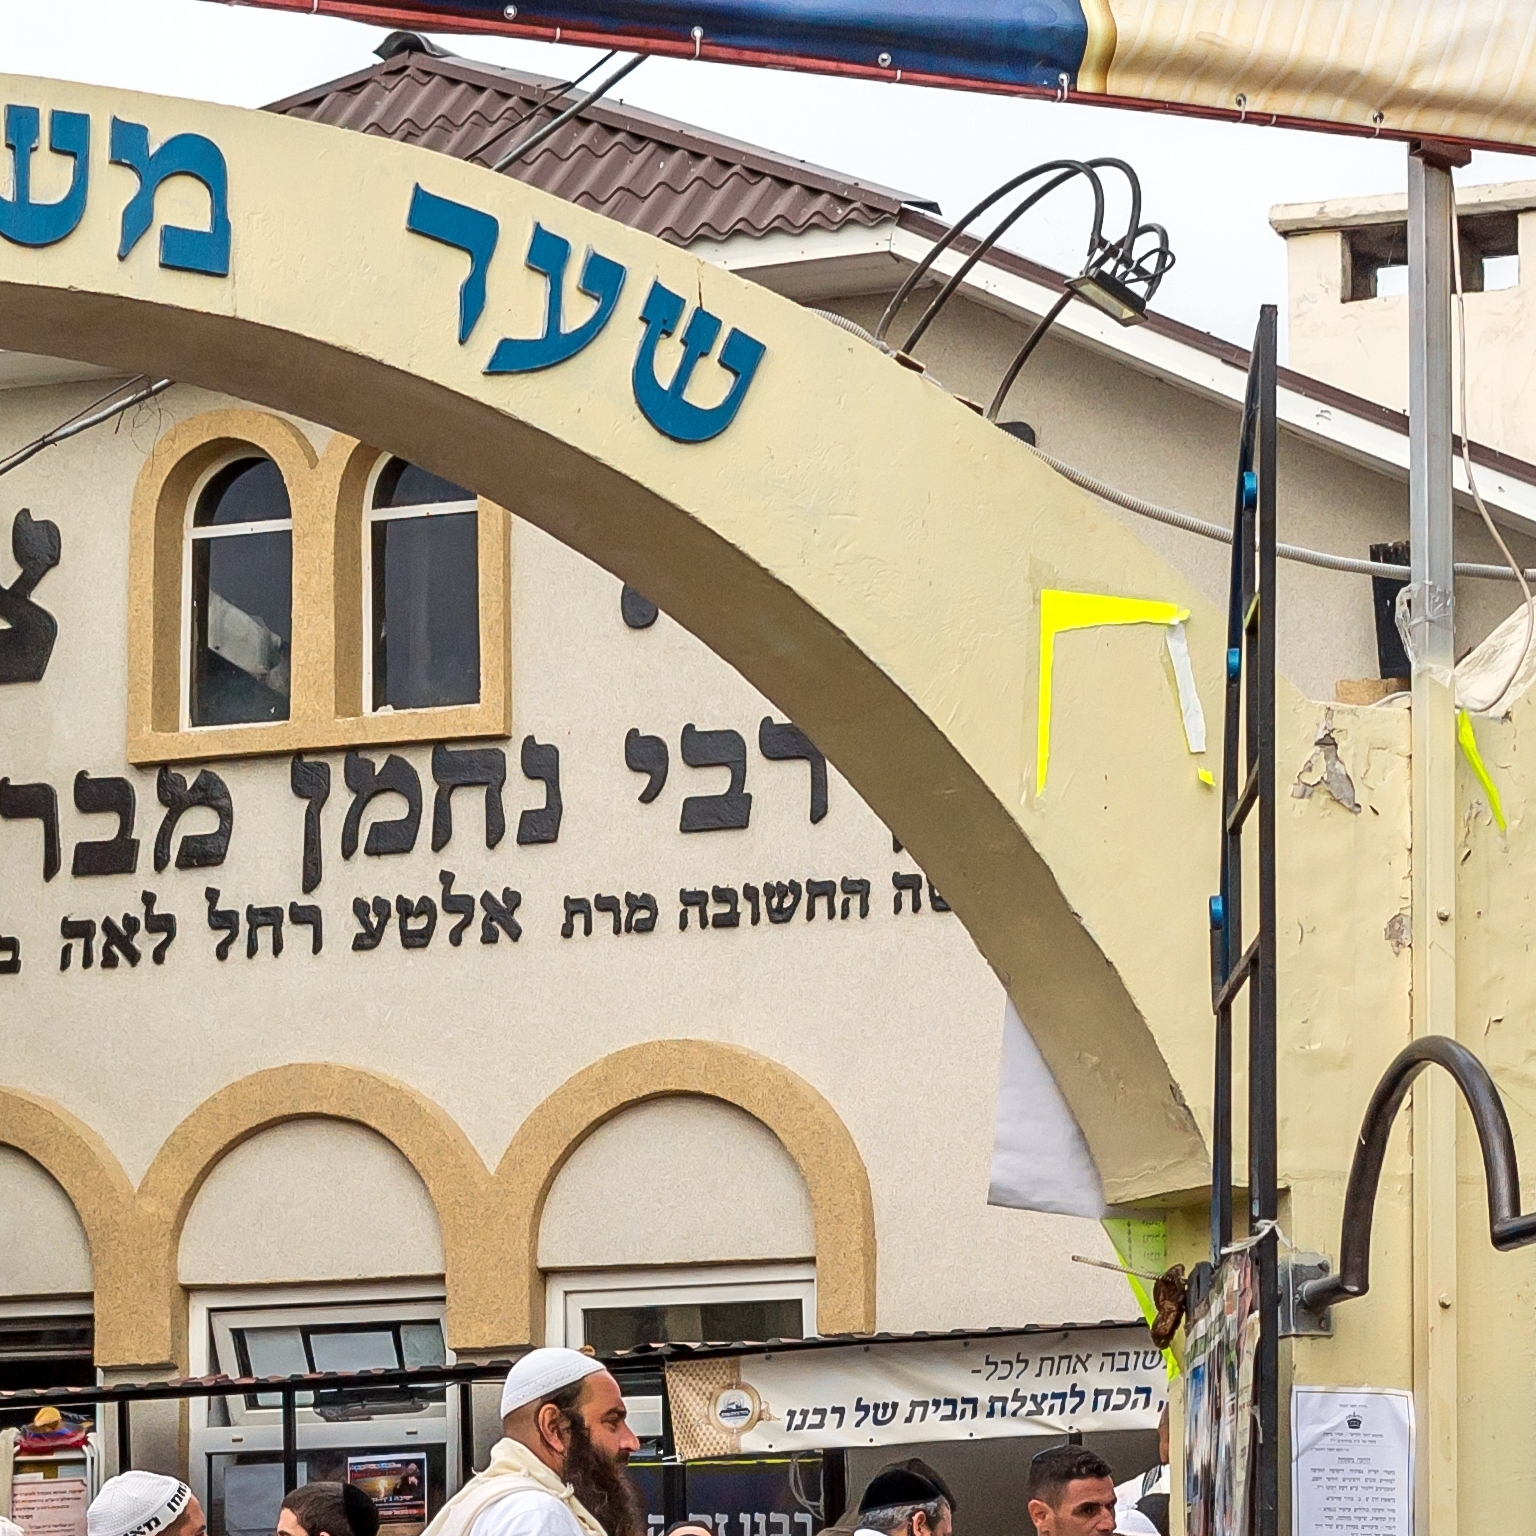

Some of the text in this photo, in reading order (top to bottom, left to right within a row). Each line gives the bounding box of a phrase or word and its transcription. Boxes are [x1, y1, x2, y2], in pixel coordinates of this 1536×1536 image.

[407, 181, 767, 444] שער
[624, 716, 827, 832] רבי
[289, 735, 562, 894] נחמן
[58, 888, 179, 975] לאה
[204, 885, 324, 962] רחל
[349, 869, 523, 956] אלטע
[558, 890, 658, 941] מרת
[676, 875, 874, 934] החשובה
[1035, 1354, 1093, 1379] אחת
[1099, 1350, 1167, 1373] שובה
[785, 1383, 1153, 1433] הכח להצלת הבית של רבנו
